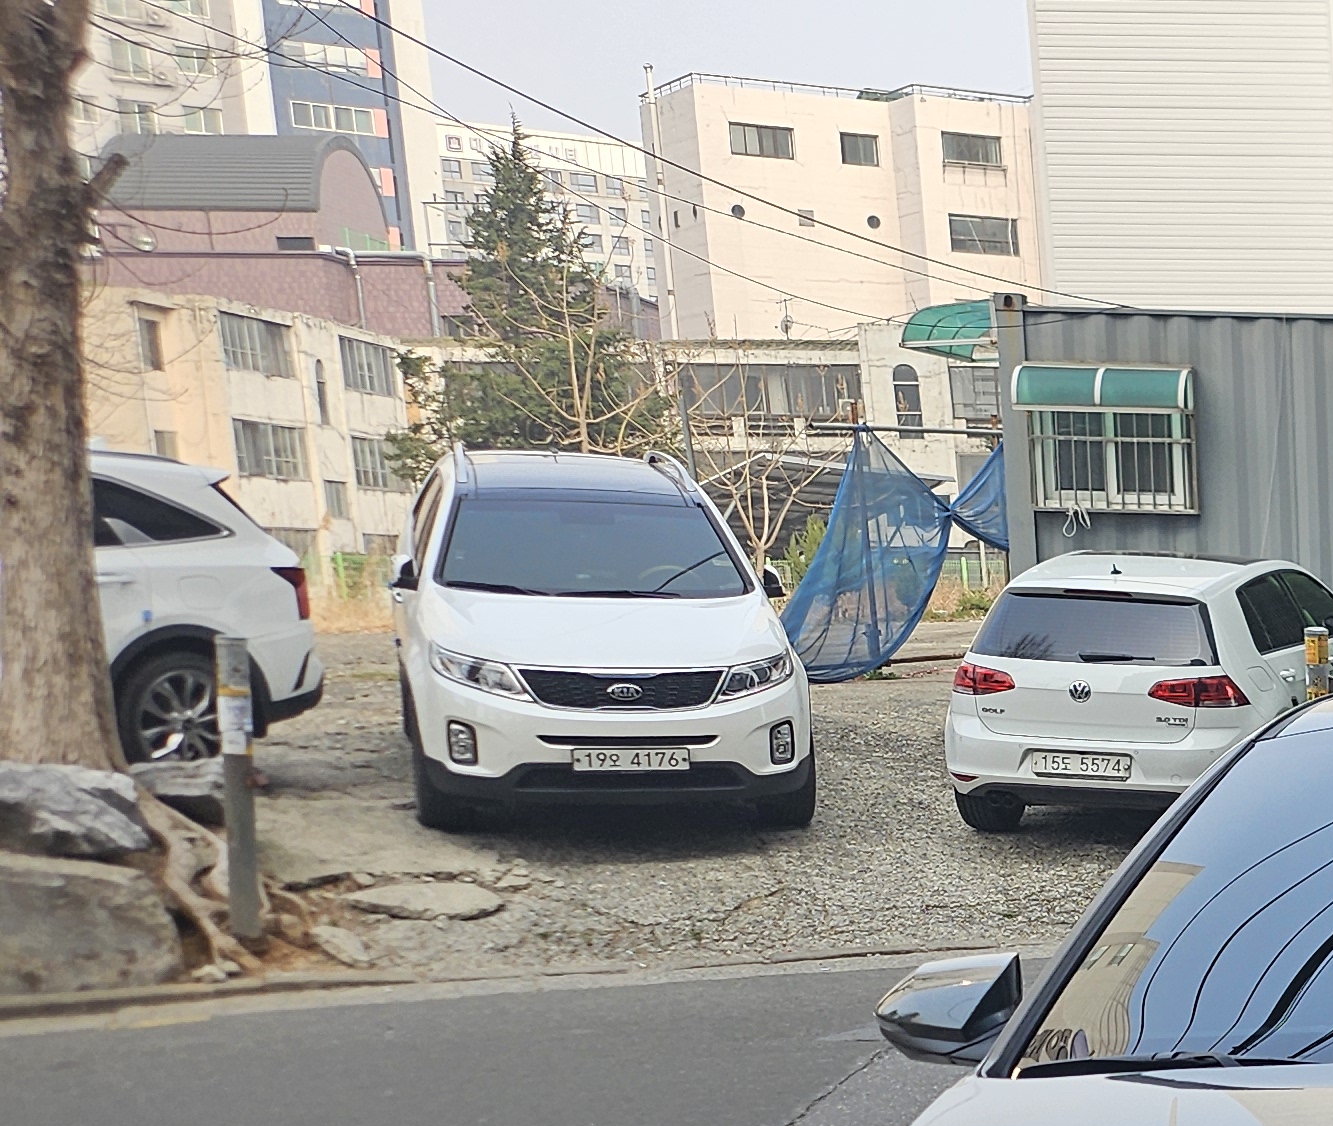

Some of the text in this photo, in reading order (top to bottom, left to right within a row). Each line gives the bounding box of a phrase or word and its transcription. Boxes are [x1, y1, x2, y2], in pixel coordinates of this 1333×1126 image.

[584, 751, 680, 768] 19오 4176
[1041, 753, 1123, 774] 15도 5574
